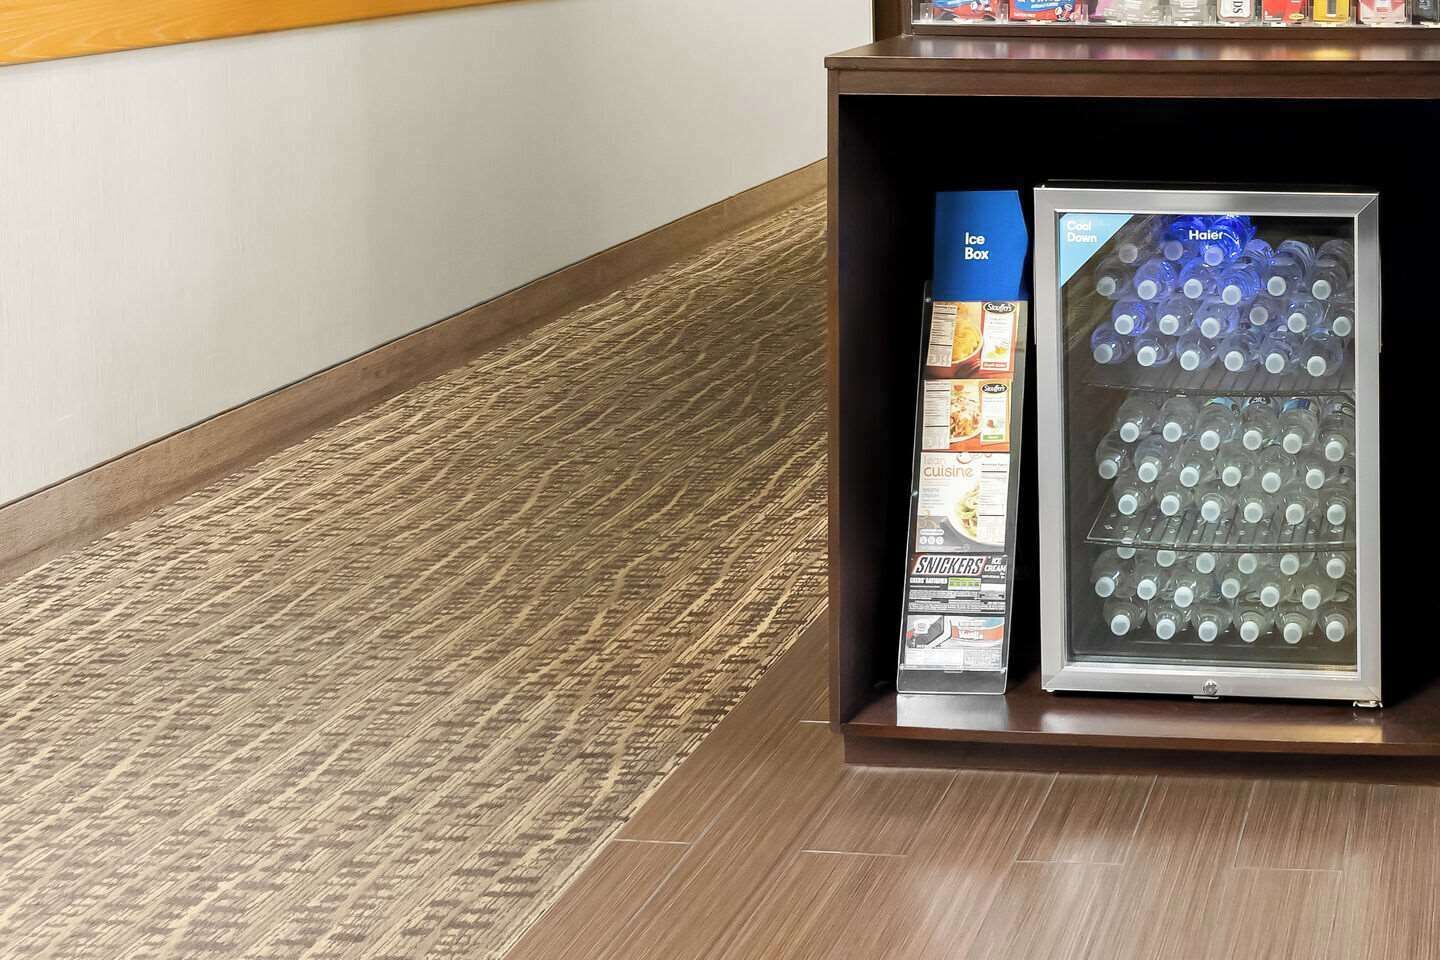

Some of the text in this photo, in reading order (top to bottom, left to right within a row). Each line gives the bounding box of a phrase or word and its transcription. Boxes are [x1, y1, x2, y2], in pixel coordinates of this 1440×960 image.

[1066, 220, 1092, 231] Cool
[965, 232, 985, 245] Ice
[1066, 232, 1097, 243] Down
[1188, 230, 1224, 241] Haier
[965, 247, 989, 260] Box
[923, 465, 974, 478] cuisine
[915, 556, 984, 575] SNICKERS
